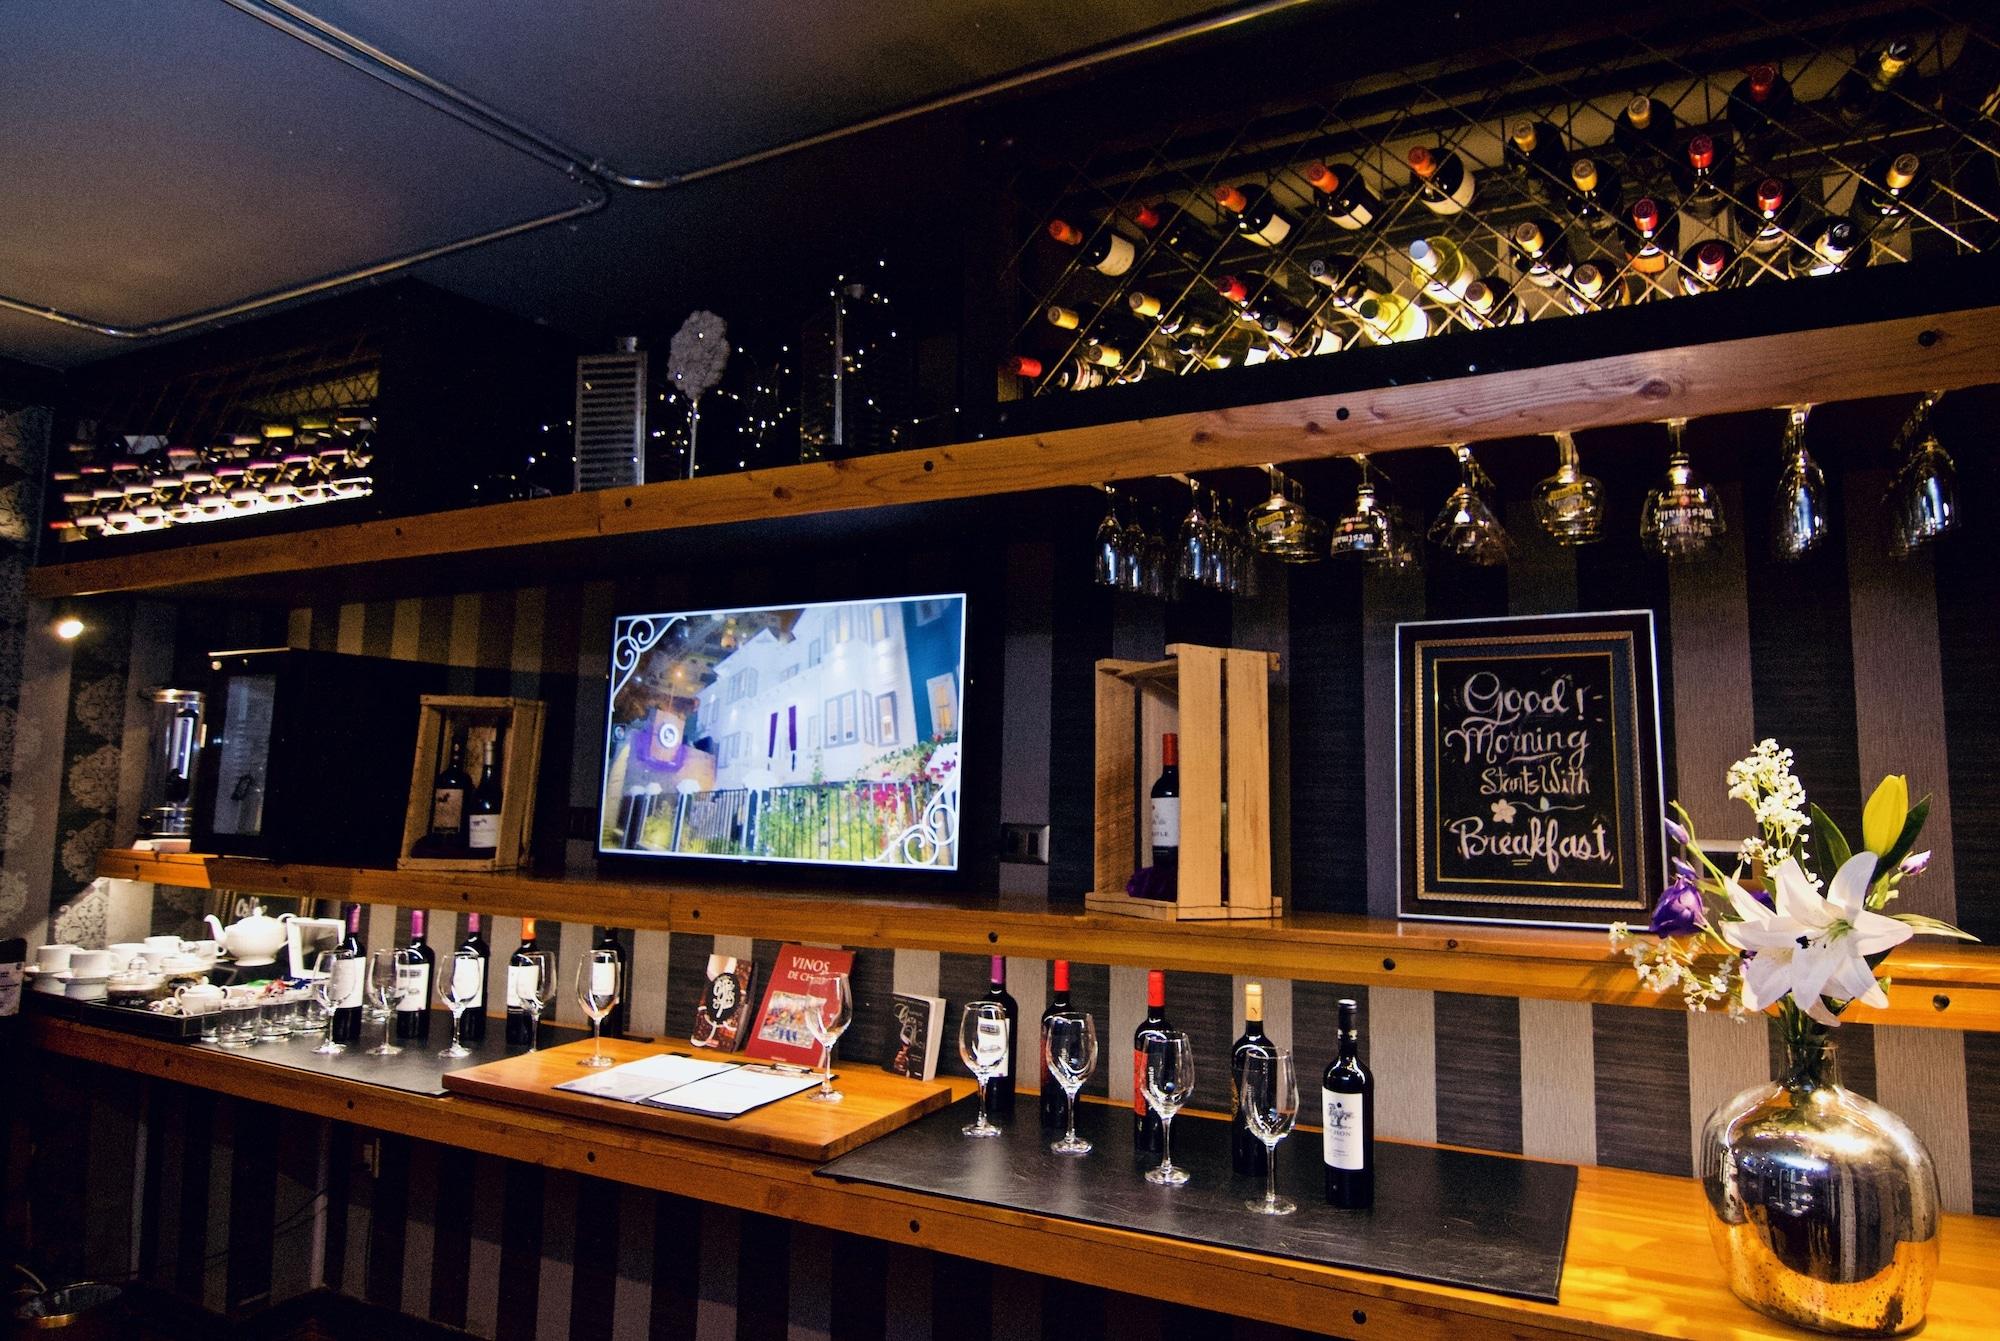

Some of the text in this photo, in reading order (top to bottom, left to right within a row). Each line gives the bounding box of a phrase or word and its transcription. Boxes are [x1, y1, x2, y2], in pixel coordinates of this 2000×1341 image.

[1445, 718, 1591, 769] Morning
[1480, 758, 1590, 795] Starts With
[1450, 816, 1613, 873] Breakfast
[787, 970, 799, 981] DE
[792, 956, 830, 974] VINOS
